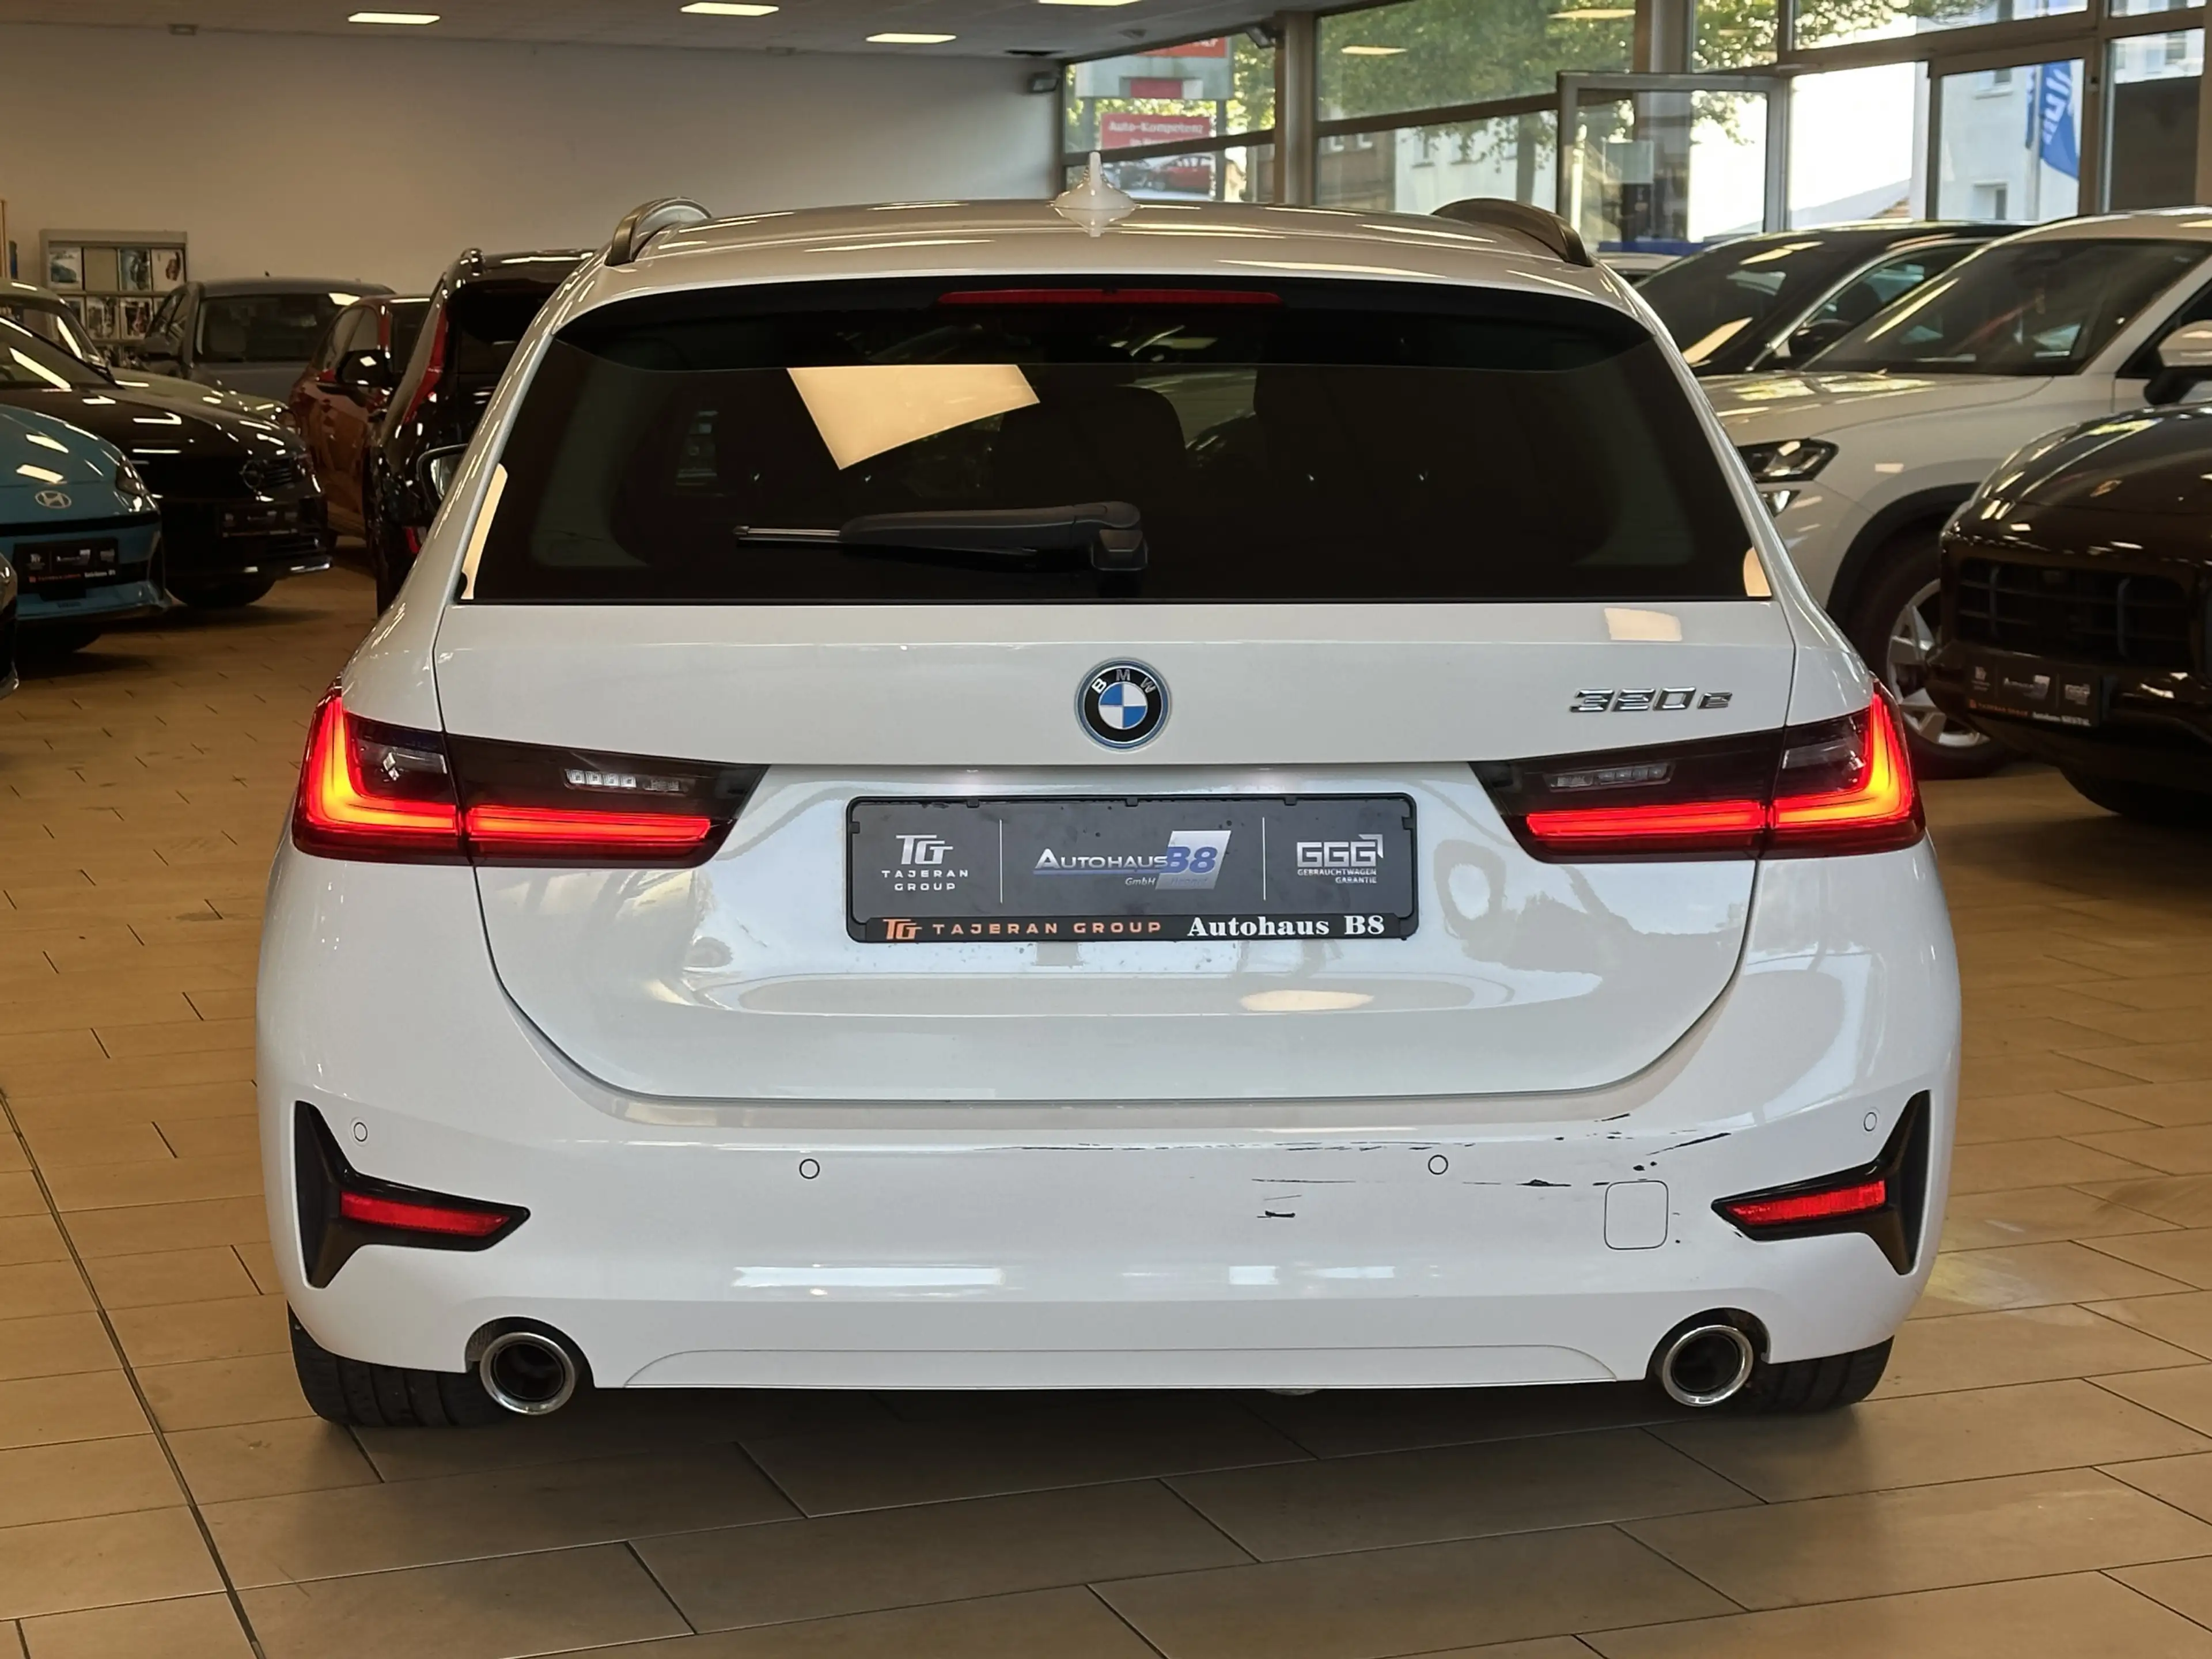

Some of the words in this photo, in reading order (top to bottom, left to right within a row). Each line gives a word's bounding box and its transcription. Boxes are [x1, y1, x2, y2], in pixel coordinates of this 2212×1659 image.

[1108, 121, 1204, 134] Auto-Kompetenz
[1092, 669, 1156, 694] BMW
[896, 834, 953, 865] TG
[1165, 846, 1218, 873] B8
[1297, 841, 1376, 867] GGG
[881, 870, 968, 878] TAJERAN
[894, 882, 956, 891] GROUP
[1125, 877, 1156, 886] GmbH
[882, 919, 923, 940] TG
[932, 923, 1058, 935] TAJERAN
[1073, 922, 1161, 933] GROUP
[1187, 916, 1330, 937] Autohaus
[1344, 915, 1385, 935] B8
